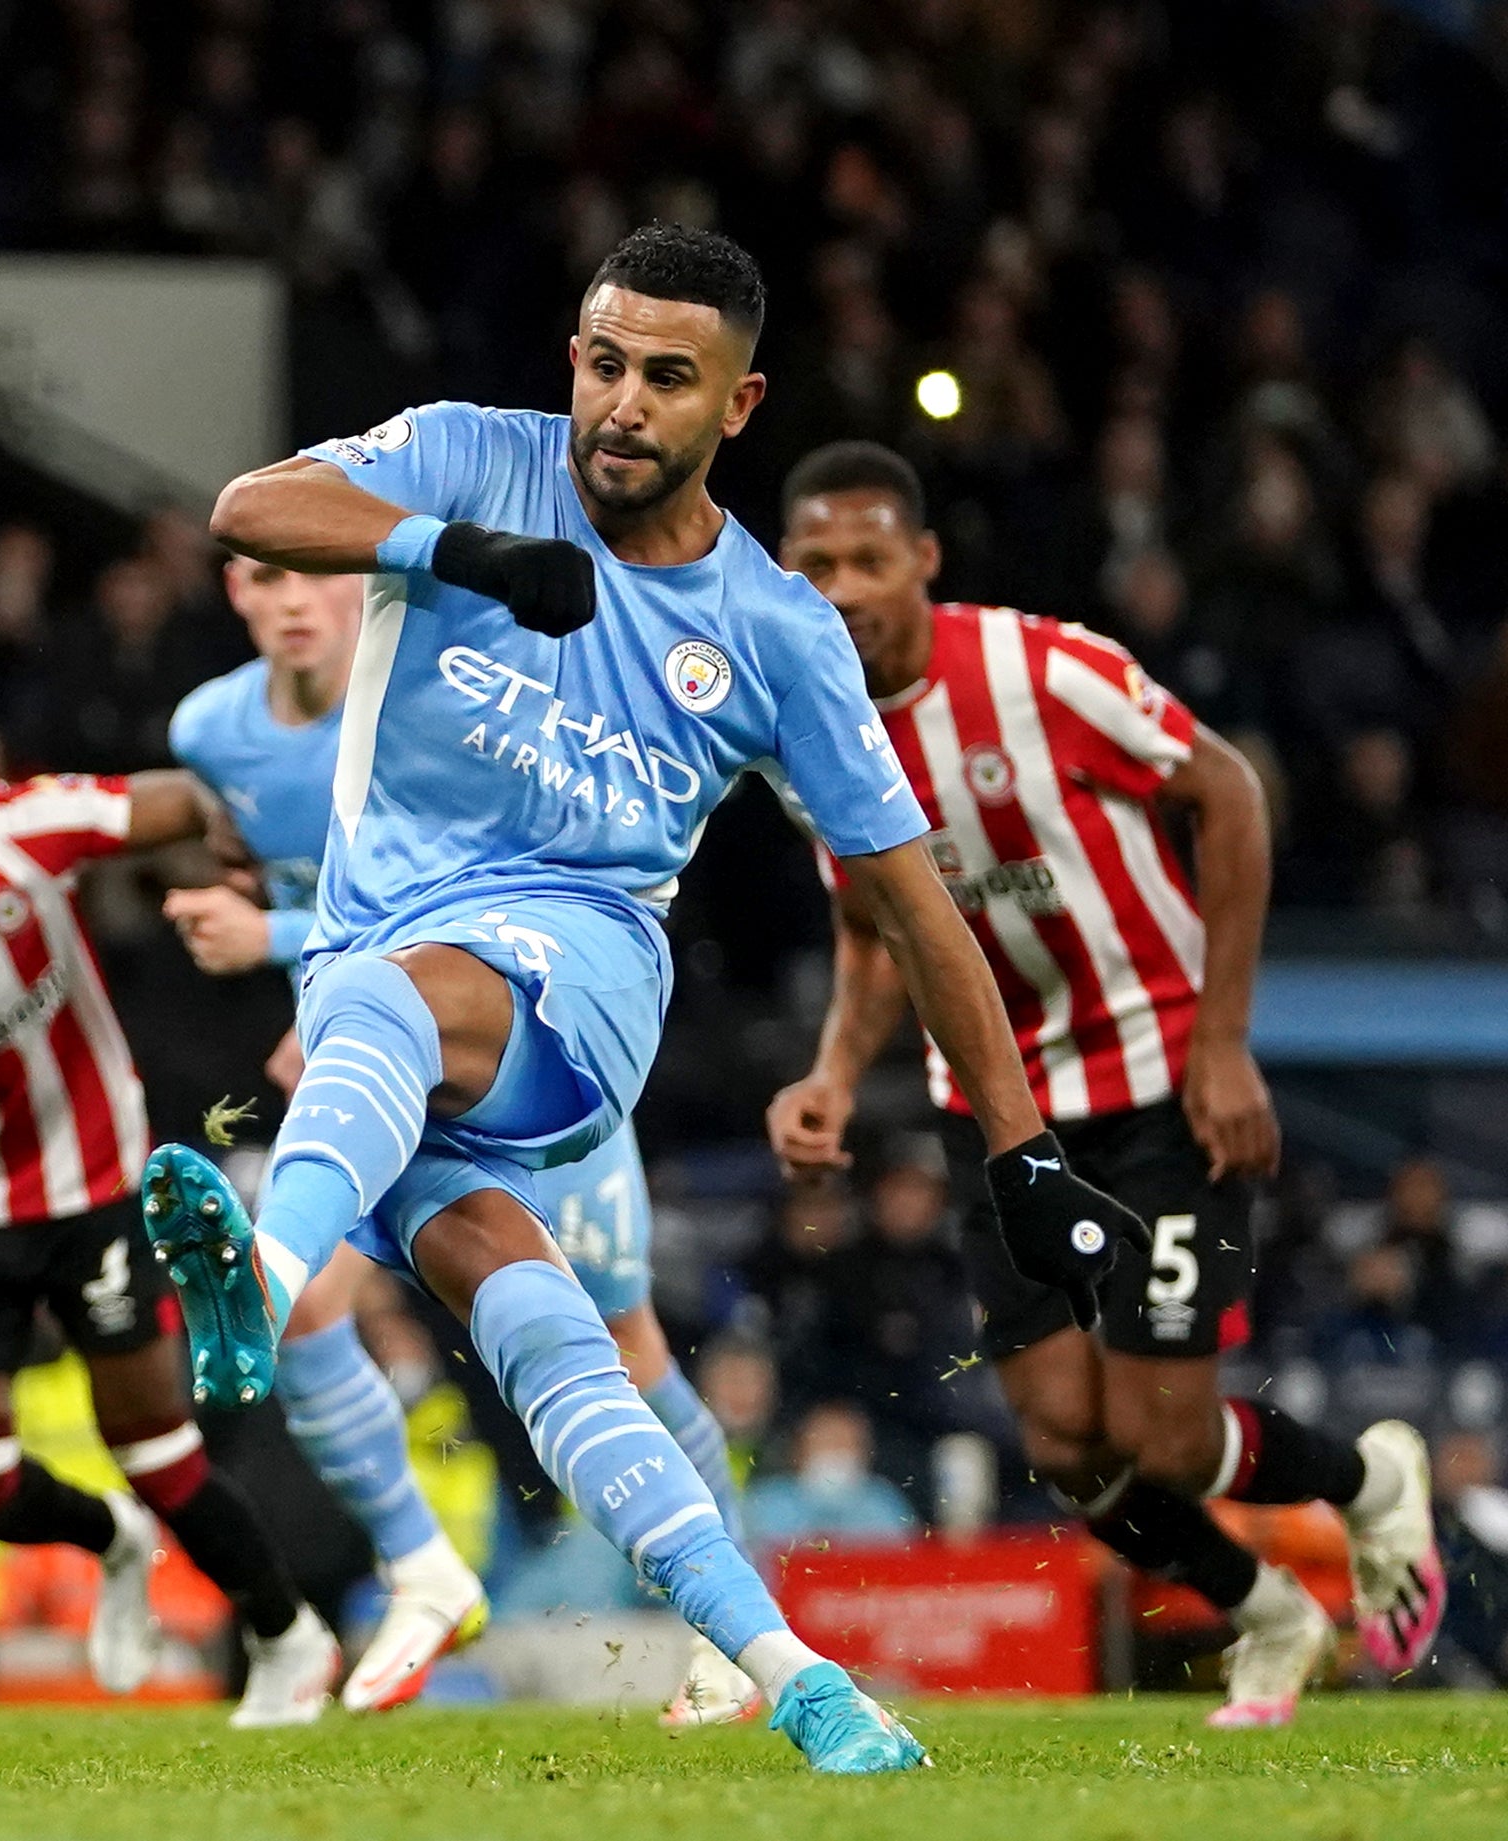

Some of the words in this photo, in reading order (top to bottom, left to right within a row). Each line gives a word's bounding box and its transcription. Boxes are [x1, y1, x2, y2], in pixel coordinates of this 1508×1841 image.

[676, 644, 729, 680] MANCHESTER
[462, 722, 644, 827] AIRWAYS
[559, 1169, 642, 1278] 41
[1147, 1213, 1200, 1304] 5
[602, 1455, 666, 1510] CITY
